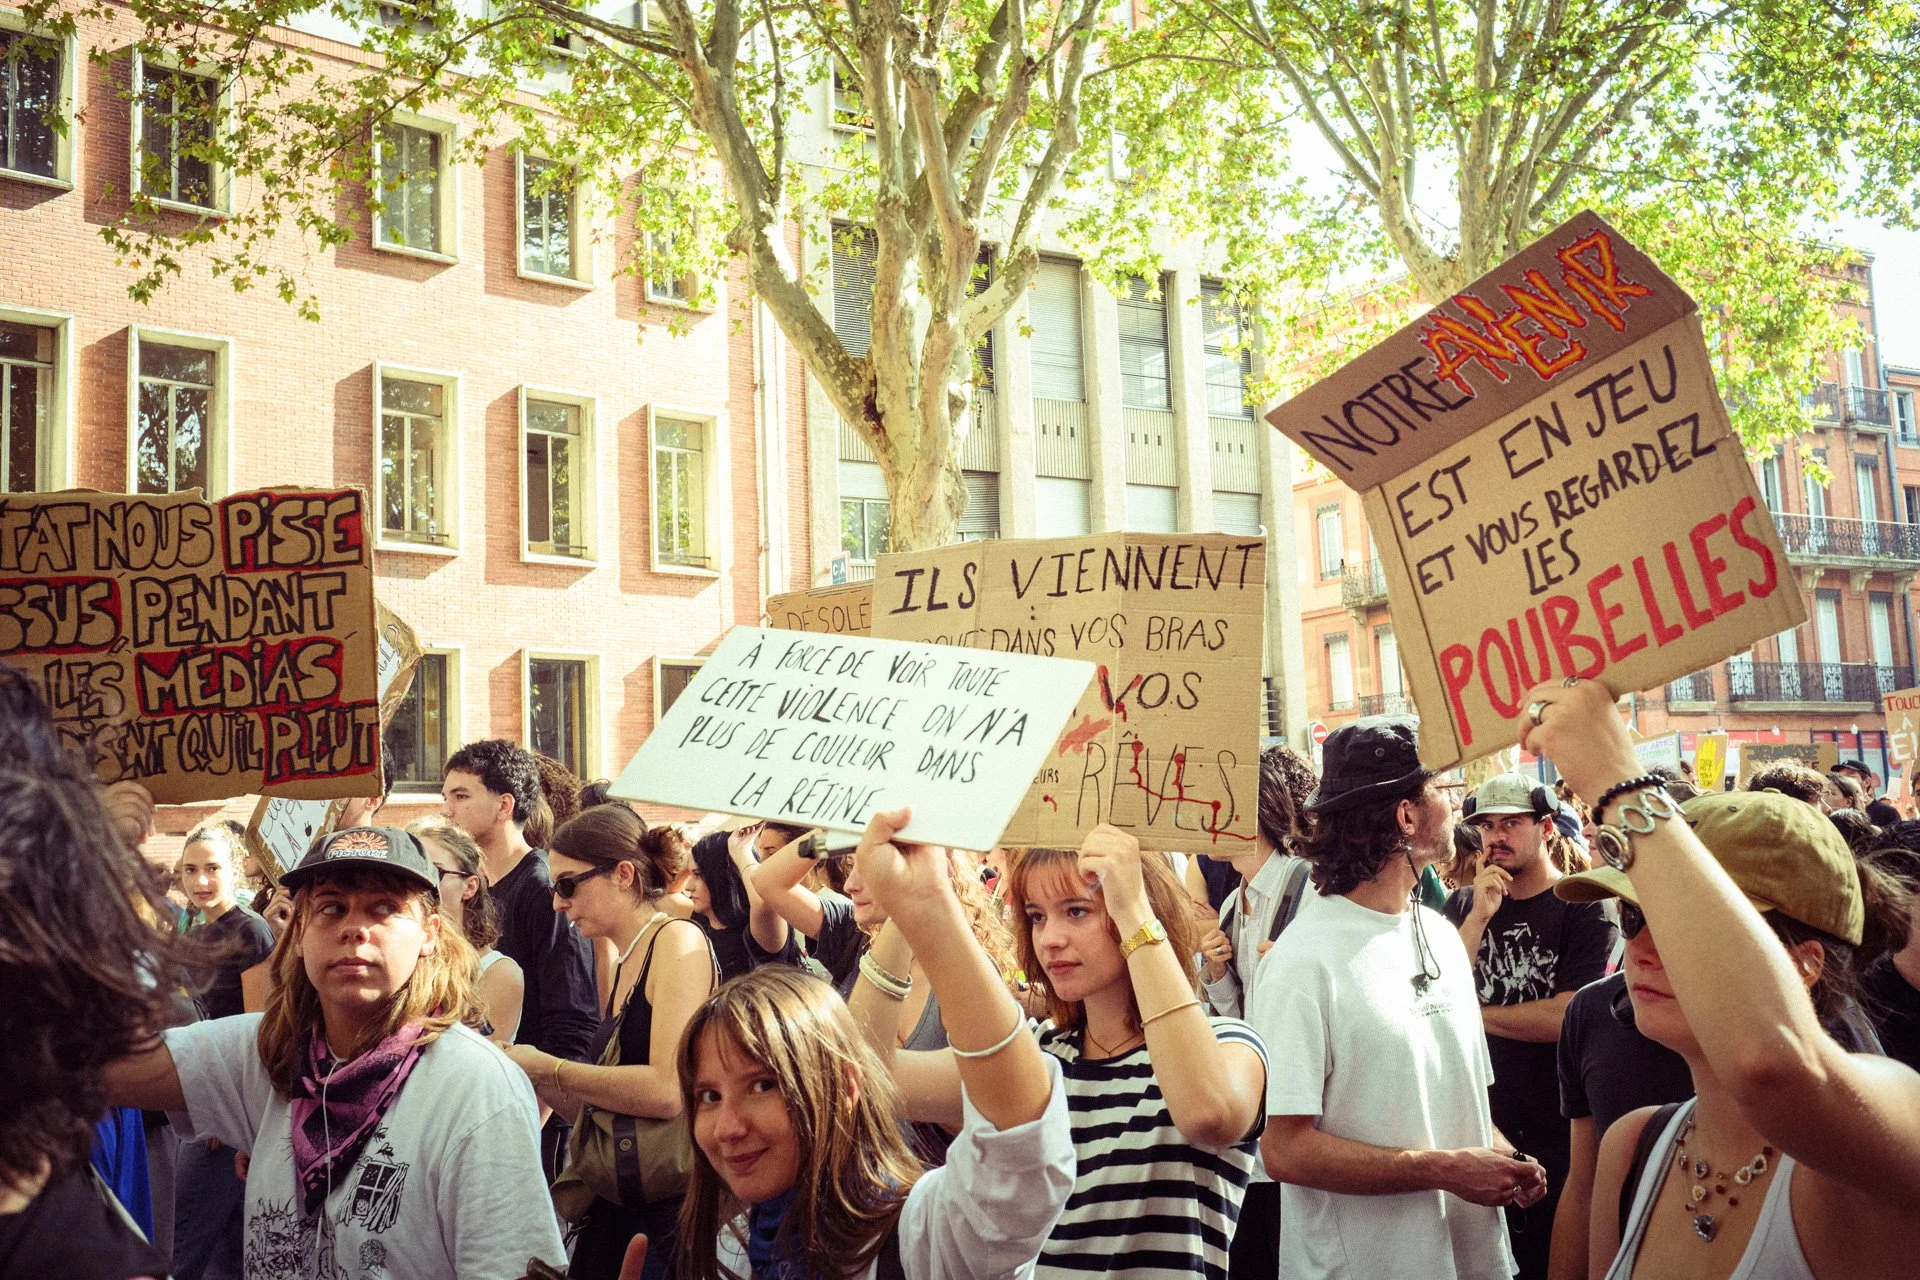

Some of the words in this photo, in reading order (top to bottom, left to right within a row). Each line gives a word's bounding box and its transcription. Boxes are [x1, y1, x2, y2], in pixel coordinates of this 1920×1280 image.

[1302, 355, 1475, 471] NOTRE
[1418, 228, 1655, 398] AVENIR
[1398, 455, 1472, 539] EST
[1499, 401, 1571, 480] EN
[1575, 343, 1678, 439] JEU
[94, 501, 215, 571] NOUS
[1416, 546, 1457, 595] ET
[1464, 500, 1540, 566] VOUS
[1545, 412, 1718, 531] REGARDEZ
[887, 561, 979, 616] ILS
[1010, 541, 1265, 601] VIENNENT
[1524, 528, 1582, 596] LES
[131, 571, 347, 649] PENDANT
[990, 627, 1057, 658] DANS
[1071, 612, 1126, 651] VOS
[1146, 614, 1230, 653] BRAS
[1438, 496, 1780, 746] POUBELLES
[44, 658, 126, 718] LES
[737, 634, 762, 670] À
[774, 638, 838, 677] FORCE
[837, 648, 875, 679] DE
[947, 662, 1010, 698] TOUTE
[1097, 666, 1203, 711] VOS
[700, 675, 776, 715] CETTE
[922, 703, 967, 737] ON
[963, 707, 1029, 747] N'A
[1884, 694, 1920, 712] TOUC
[266, 702, 380, 782] PLEUT
[678, 714, 746, 750] PLUS
[746, 727, 788, 761] DE
[792, 731, 896, 772] COULEUR
[916, 744, 983, 784] DANS
[729, 771, 771, 808] LA
[1076, 730, 1238, 834] RÊVES
